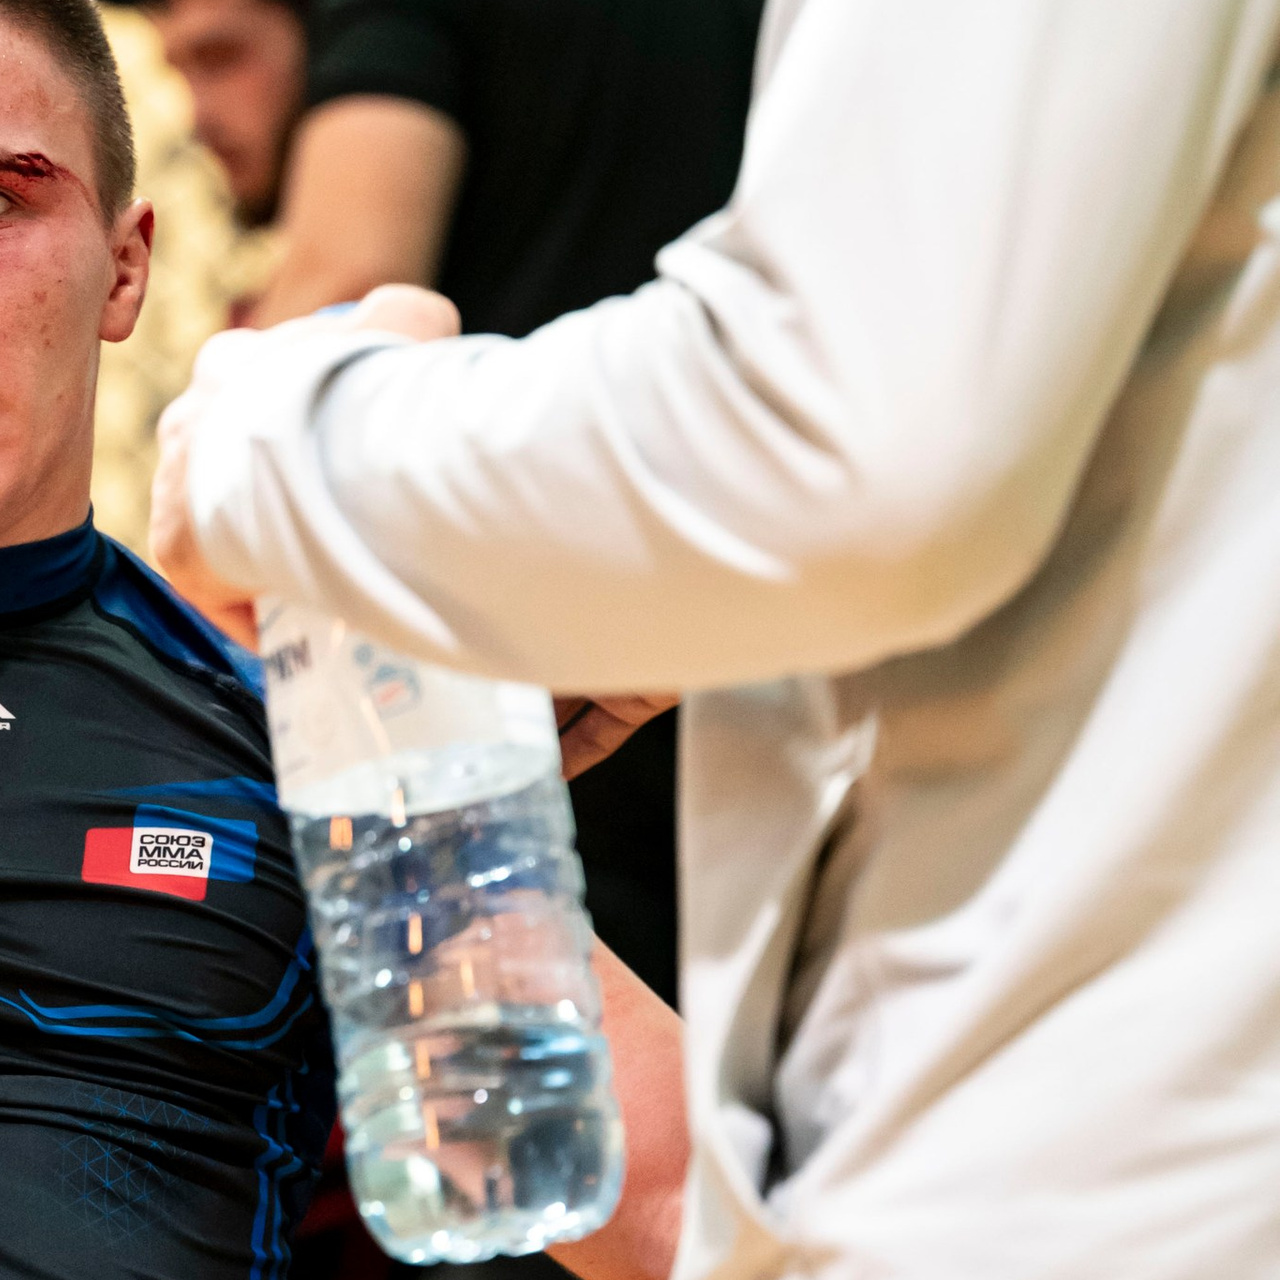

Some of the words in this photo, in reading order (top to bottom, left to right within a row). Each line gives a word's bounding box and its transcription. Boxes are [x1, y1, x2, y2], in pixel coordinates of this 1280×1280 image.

[140, 834, 206, 848] СОЮЗ
[139, 846, 203, 860] ММА
[137, 859, 203, 870] РОССИИ
